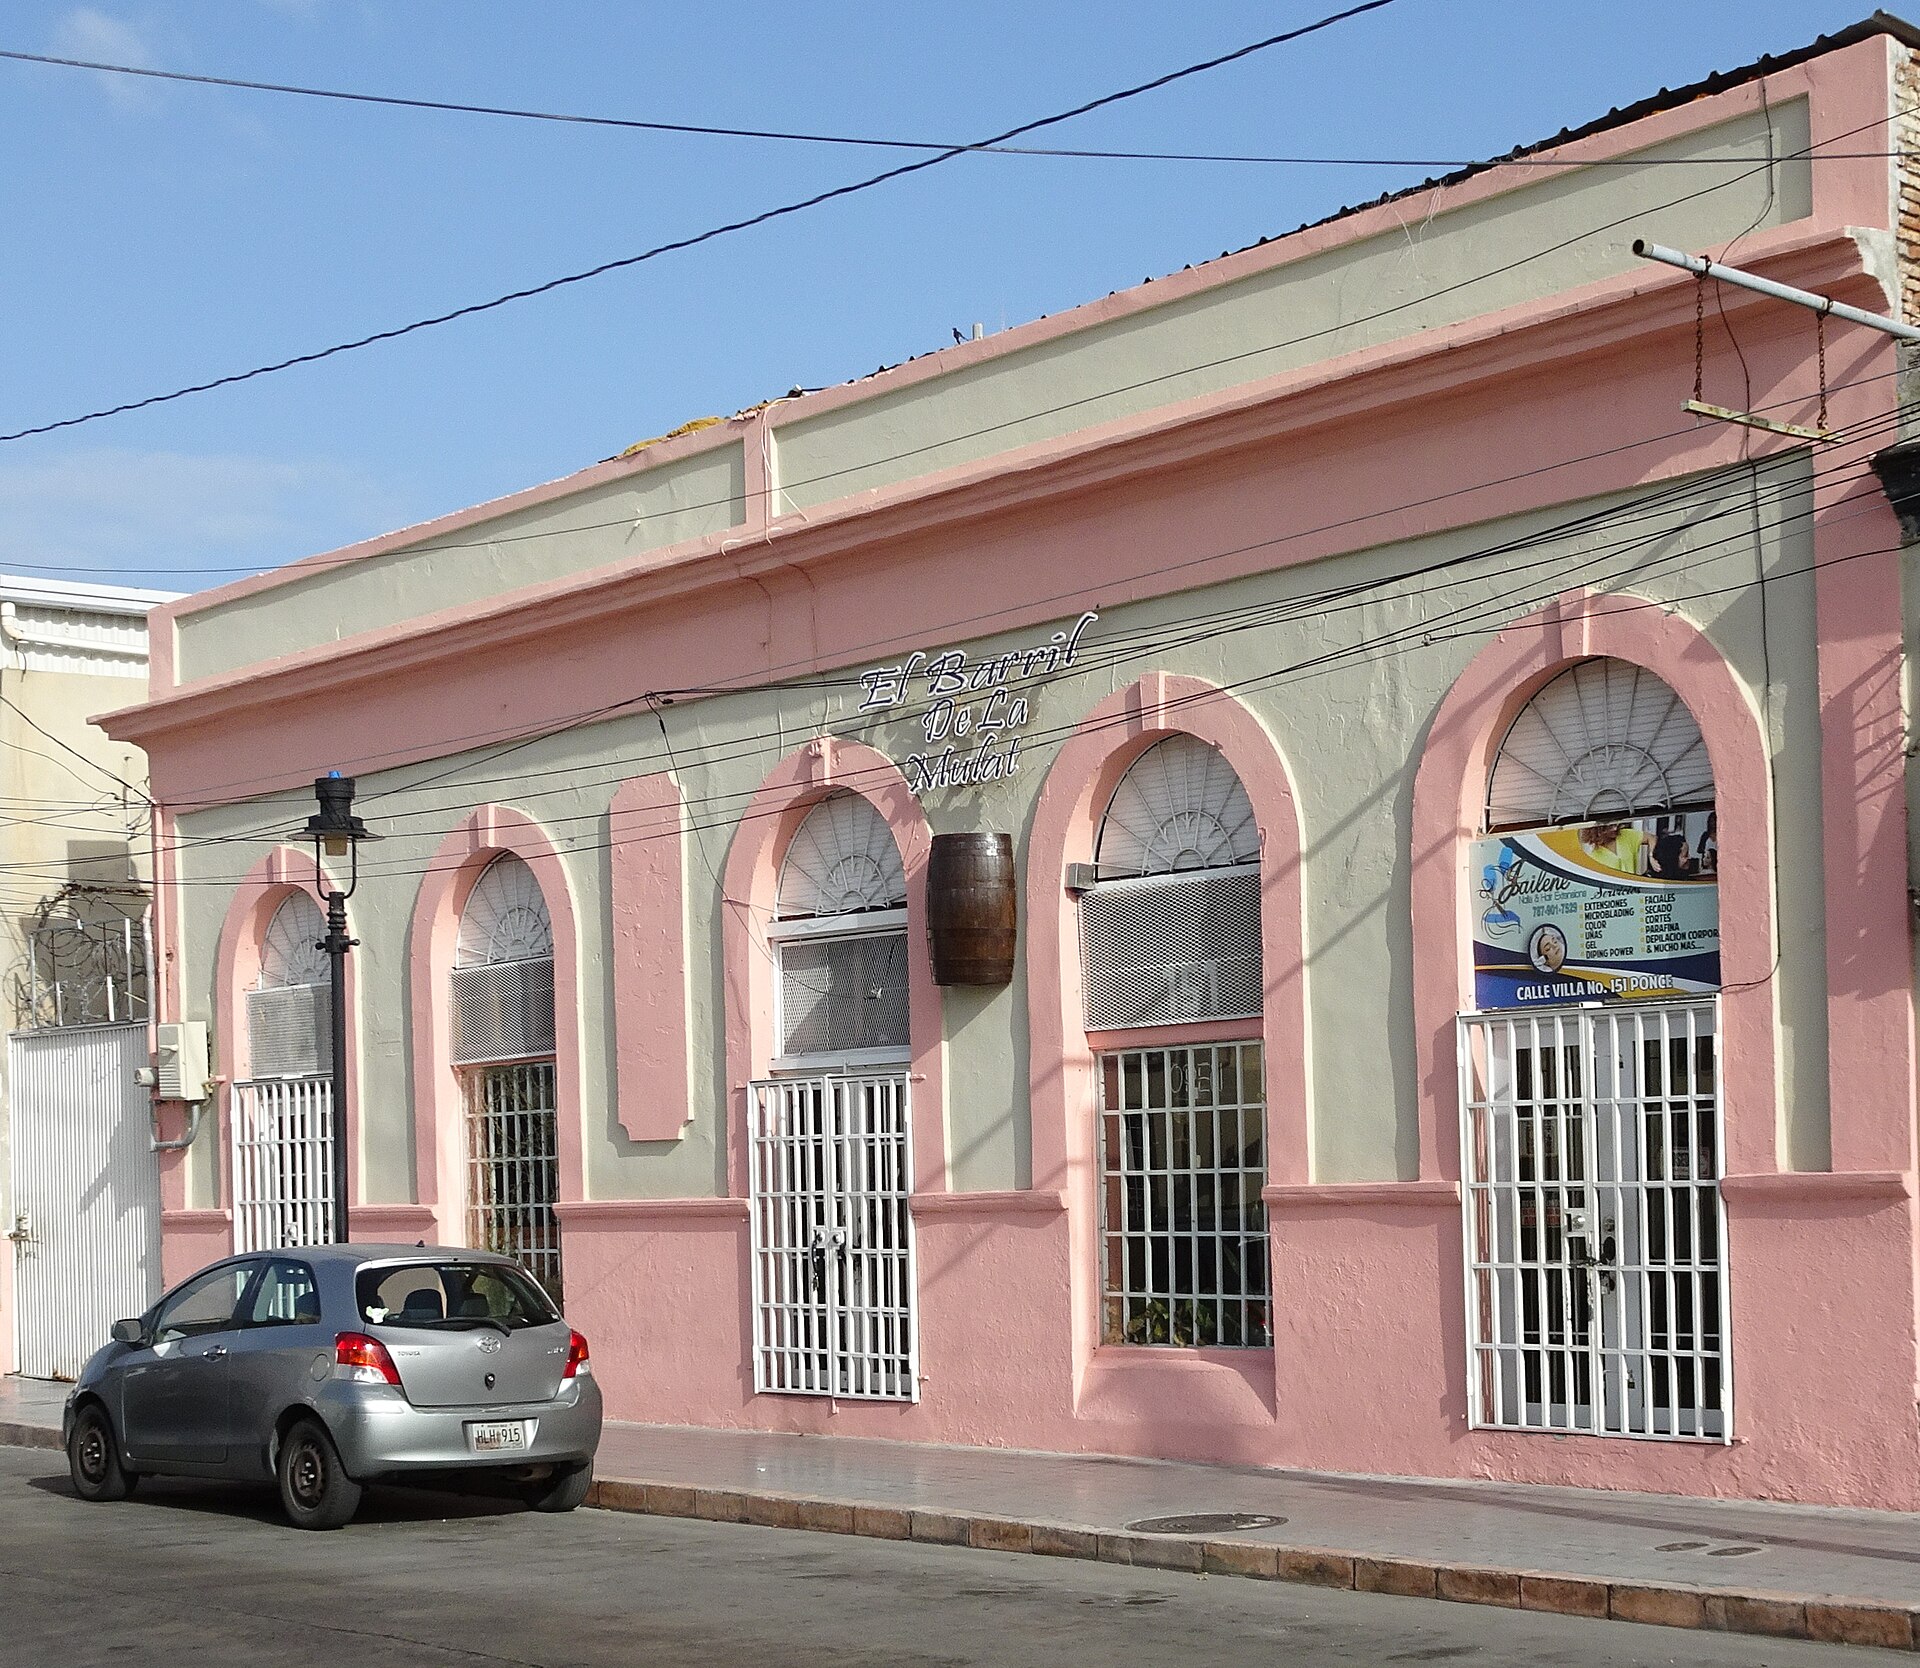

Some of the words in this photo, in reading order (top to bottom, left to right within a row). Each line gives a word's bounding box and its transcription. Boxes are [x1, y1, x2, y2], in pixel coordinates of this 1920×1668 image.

[858, 651, 925, 713] El
[924, 611, 1099, 697] Barril
[922, 697, 972, 744] De
[976, 686, 1029, 734] La
[908, 732, 1023, 794] Mulat
[1498, 858, 1571, 904] Jailene
[1644, 893, 1676, 904] FACIALES
[1584, 899, 1628, 911] EXTENSIONES
[1645, 904, 1672, 915] SECADO
[1584, 908, 1635, 920] MICROBLADING
[1645, 914, 1672, 924] CORTES
[1585, 920, 1607, 930] COLOR
[1645, 922, 1680, 934] PARAFINA
[1585, 941, 1597, 950] GEL
[1646, 945, 1653, 954] &
[1653, 943, 1680, 953] MUCHO
[1586, 949, 1609, 959] DIPING
[1610, 946, 1634, 957] POWER
[1516, 985, 1551, 1001] CALLE
[1552, 981, 1584, 997] VILLA
[1587, 980, 1608, 995] No.
[1610, 977, 1628, 993] 151
[1629, 974, 1673, 992] PONCE
[477, 1429, 496, 1443] HLH
[501, 1428, 521, 1443] 915
